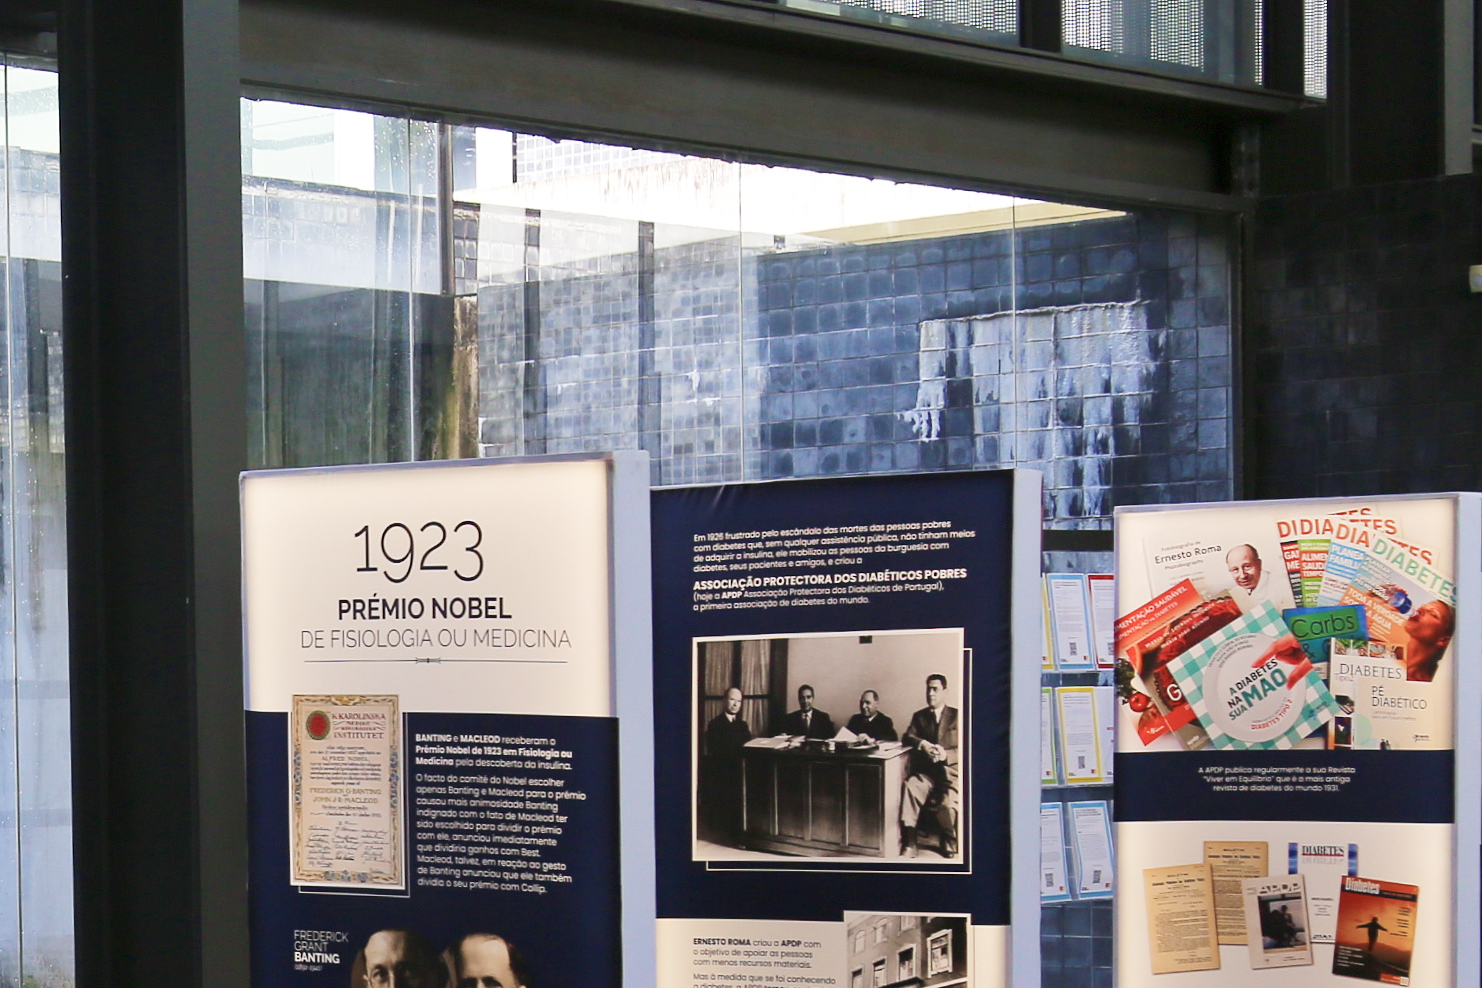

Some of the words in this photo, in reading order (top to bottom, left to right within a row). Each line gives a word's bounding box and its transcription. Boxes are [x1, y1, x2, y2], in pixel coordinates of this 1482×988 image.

[693, 534, 706, 542] Em
[707, 532, 724, 541] 1926
[724, 531, 760, 539] frustrado
[761, 529, 779, 539] pelo
[780, 527, 822, 536] escândalo
[822, 526, 838, 534] das
[886, 523, 921, 532] pessoas
[921, 521, 951, 530] pobres
[354, 521, 483, 582] 1923
[1154, 552, 1192, 564] Ernesto
[1194, 545, 1222, 556] Roma
[693, 577, 762, 590] ASSOCIAÇÃO
[763, 574, 832, 586] PROTECTORA
[833, 573, 857, 583] DOS
[858, 570, 922, 582] DIABÉTICOS
[924, 568, 967, 581] POBRES
[338, 594, 424, 619] PRÉMIO
[432, 597, 512, 618] NOBEL
[1292, 614, 1355, 638] Carbs
[301, 630, 325, 648] DE
[331, 629, 433, 647] FISIOLOGIA
[437, 628, 466, 647] OU
[473, 628, 571, 647] MEDICINA
[1235, 658, 1278, 691] DIABETES
[1340, 663, 1402, 679] DIABETES
[1372, 685, 1384, 697] PÉ
[1228, 696, 1242, 709] NA
[1372, 696, 1428, 710] DIABÉTICO
[1229, 705, 1248, 721] SUA
[415, 733, 452, 746] BANTING
[452, 735, 459, 746] e
[459, 734, 501, 747] MACLEOD
[501, 737, 548, 748] receberam
[549, 738, 556, 749] o
[415, 745, 445, 757] Prémio
[445, 746, 470, 754] Nobel
[471, 746, 482, 754] de
[483, 746, 502, 755] 1923
[518, 747, 559, 759] Fisiologia
[560, 750, 572, 758] ou
[1302, 846, 1344, 856] DIABETES
[1345, 877, 1381, 895] Diabetes
[294, 930, 348, 944] FREDERICK
[780, 939, 802, 947] APDP
[294, 940, 328, 954] GRANT
[294, 952, 340, 963] BANTING
